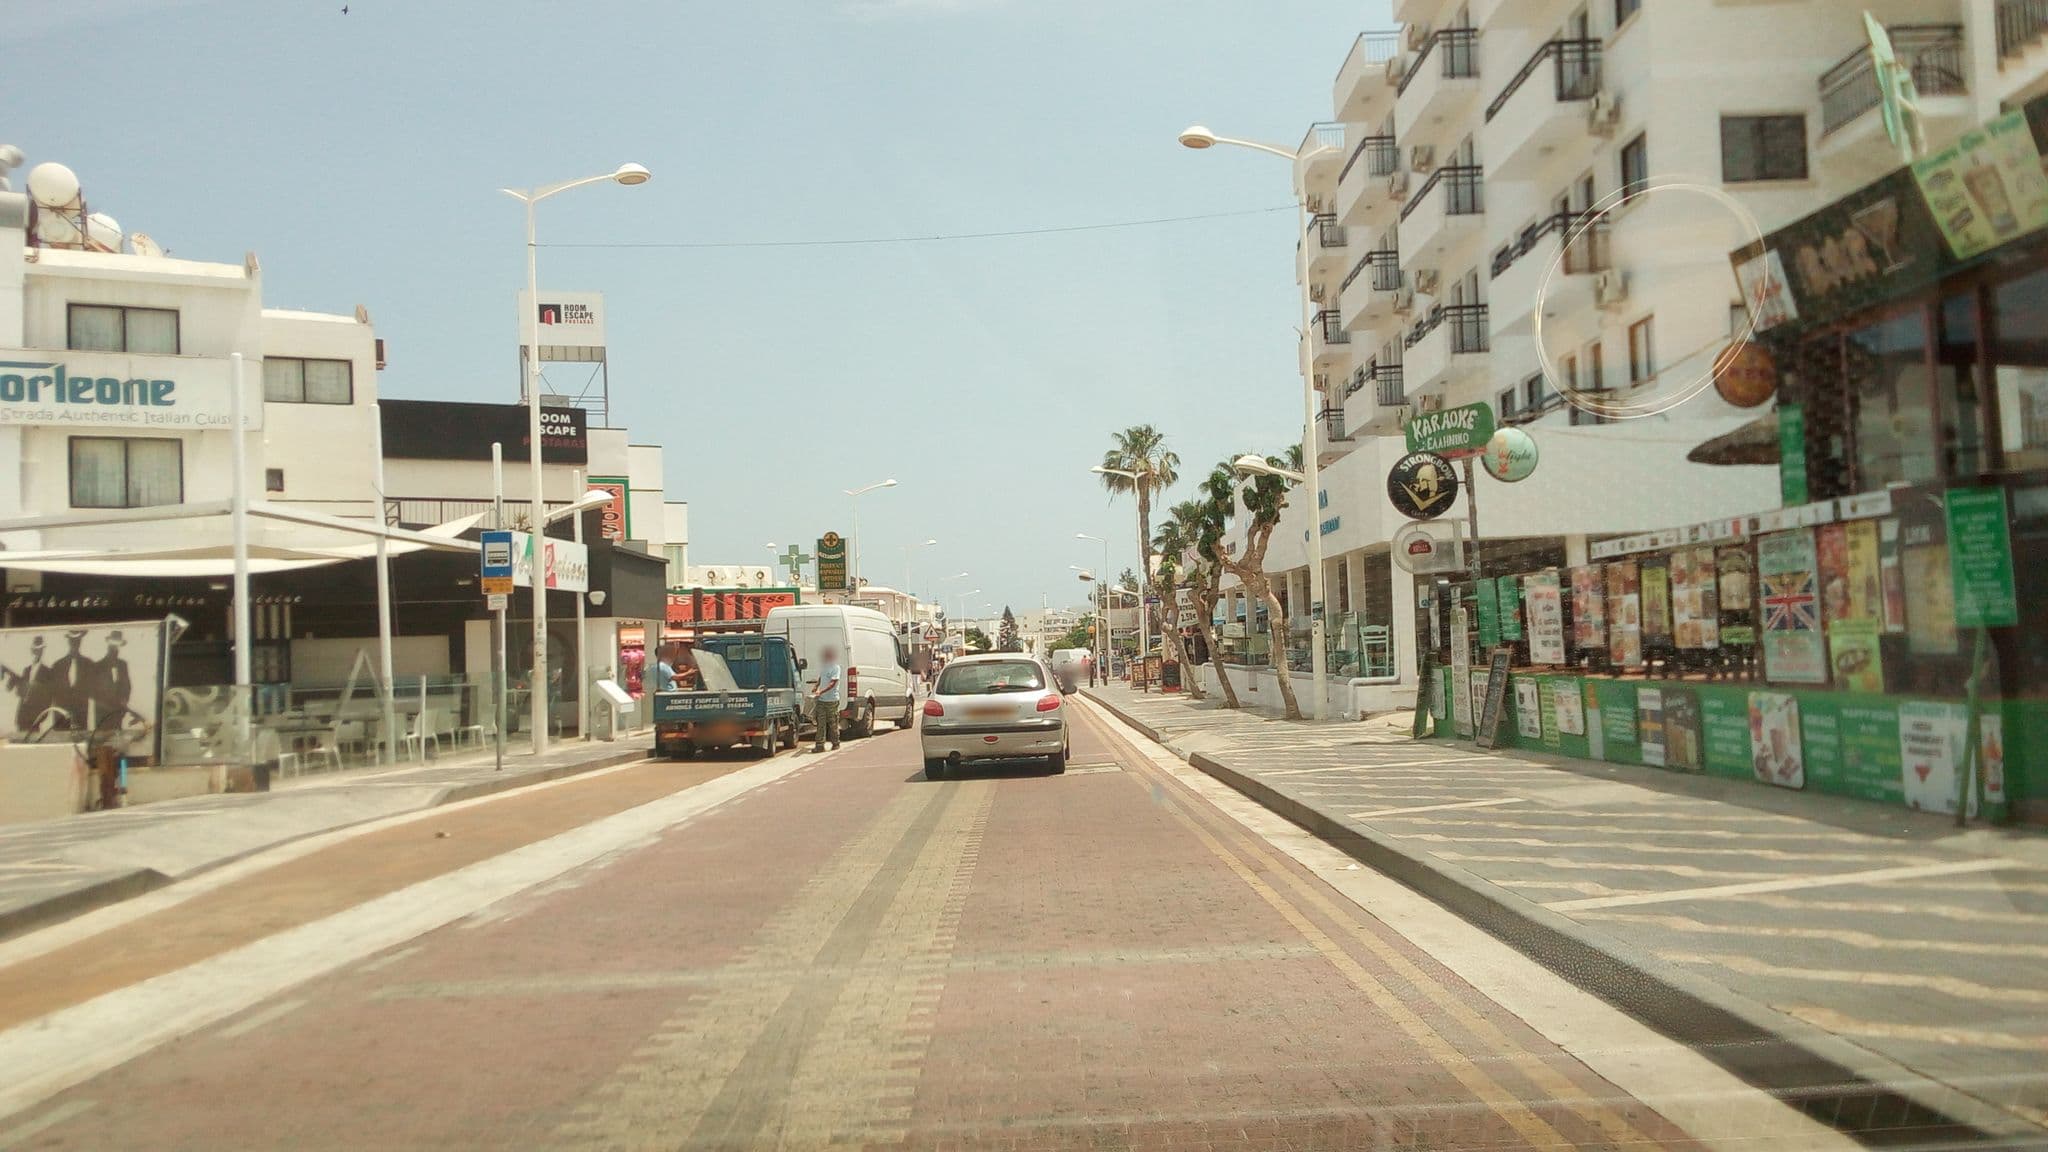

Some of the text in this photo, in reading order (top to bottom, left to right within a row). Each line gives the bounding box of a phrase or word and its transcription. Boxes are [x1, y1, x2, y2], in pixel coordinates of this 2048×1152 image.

[564, 304, 587, 312] ROOM
[564, 311, 594, 320] ESCAPE
[0, 407, 54, 422] Strada
[58, 408, 140, 424] Authentic
[143, 410, 191, 425] Italian
[540, 413, 572, 424] OOM
[539, 424, 577, 436] SCAPE
[1411, 408, 1479, 444] KARAOKE
[1400, 454, 1455, 481] STRONGBOW
